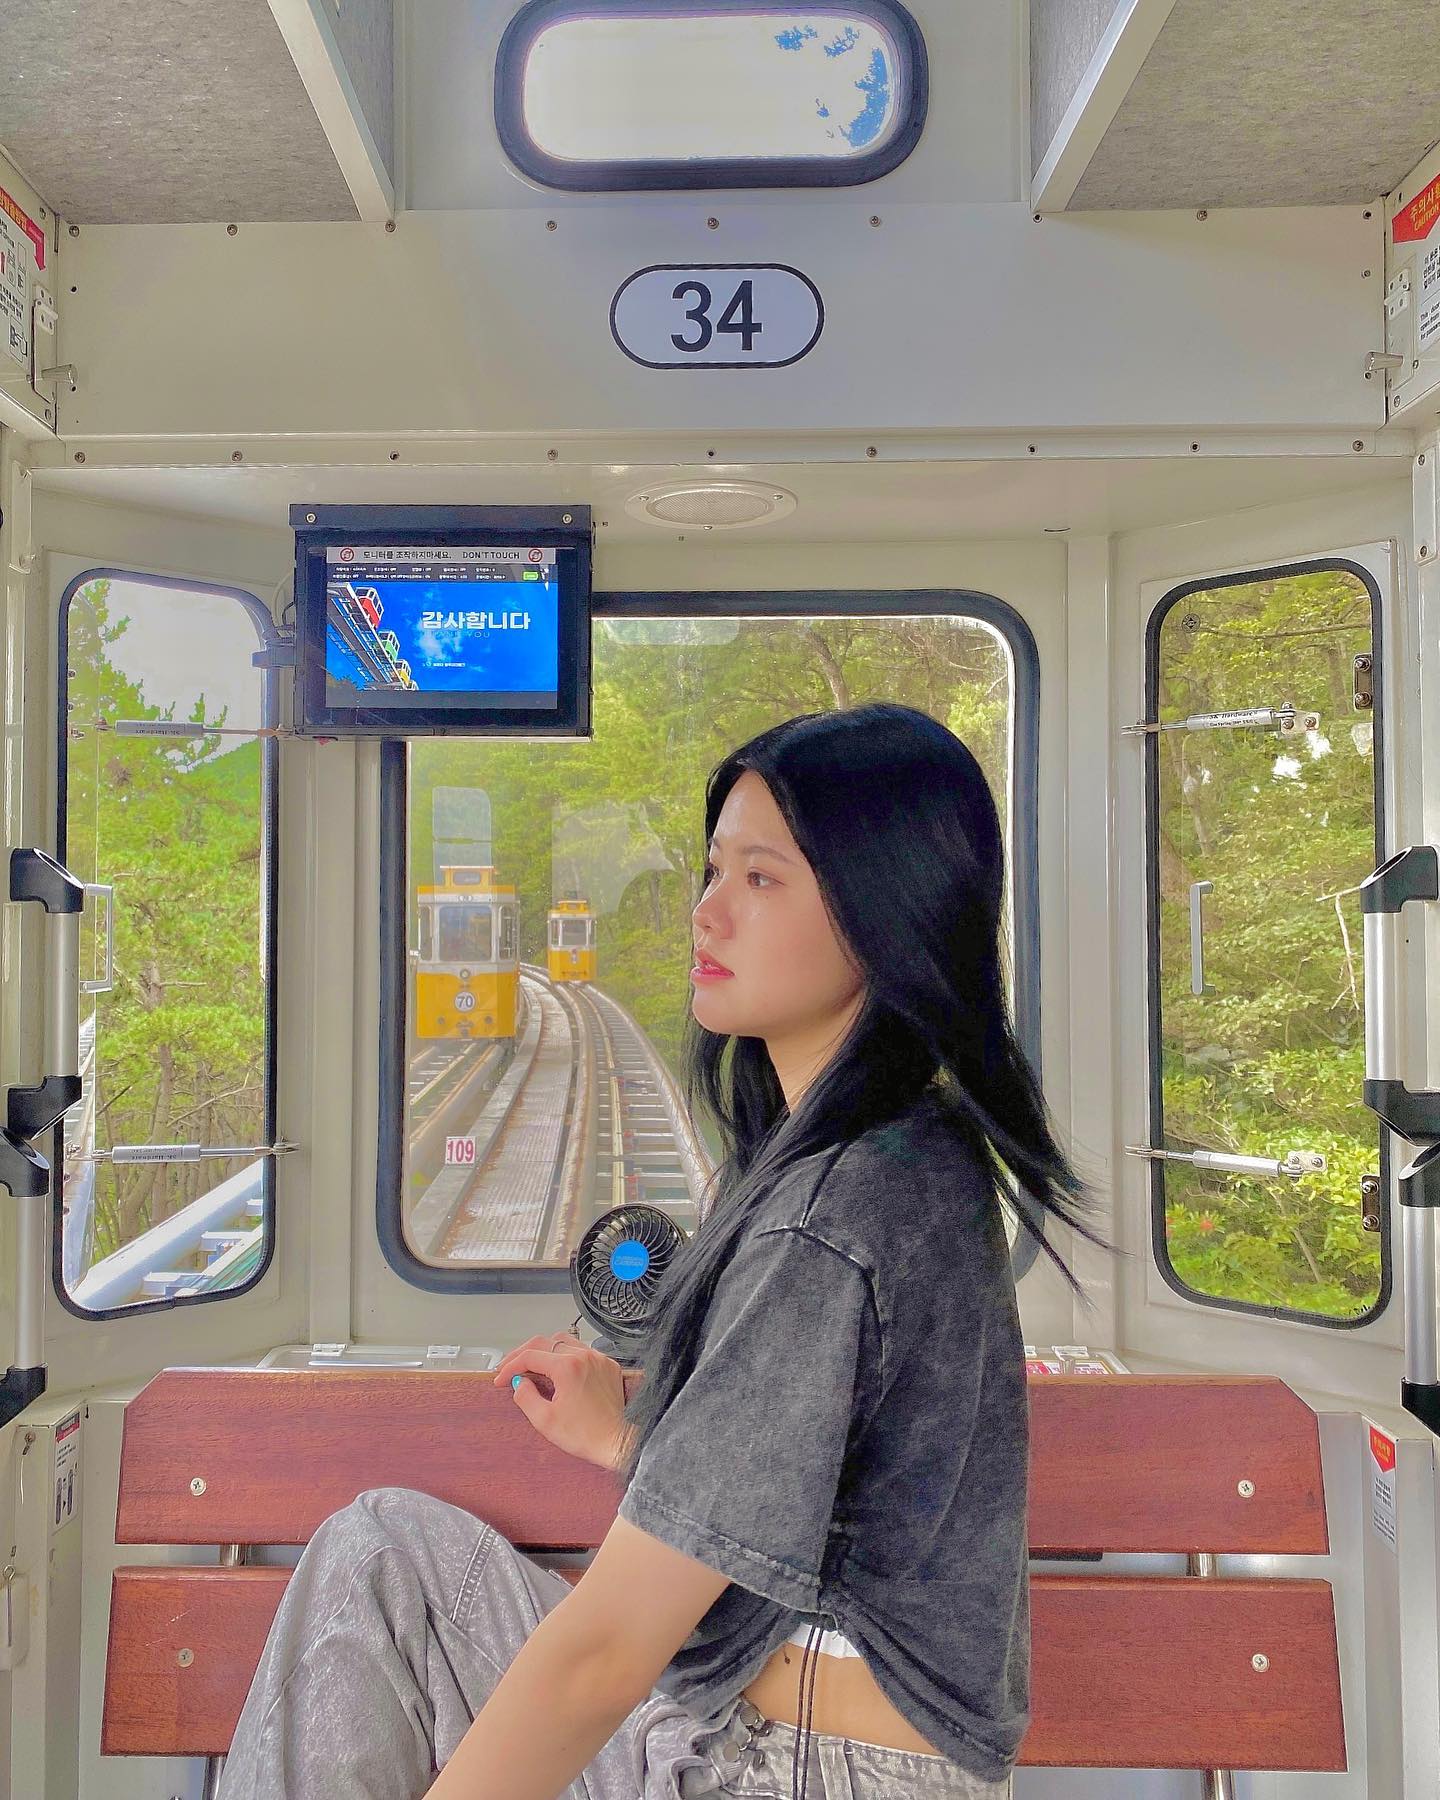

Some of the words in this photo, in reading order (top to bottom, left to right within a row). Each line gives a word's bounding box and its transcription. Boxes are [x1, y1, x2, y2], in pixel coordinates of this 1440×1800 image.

[671, 280, 763, 352] 34
[363, 550, 394, 560] 모니터를
[490, 551, 520, 560] TOUCH
[422, 611, 531, 630] 감사합니다
[457, 996, 474, 1009] 70
[447, 1139, 474, 1162] 109
